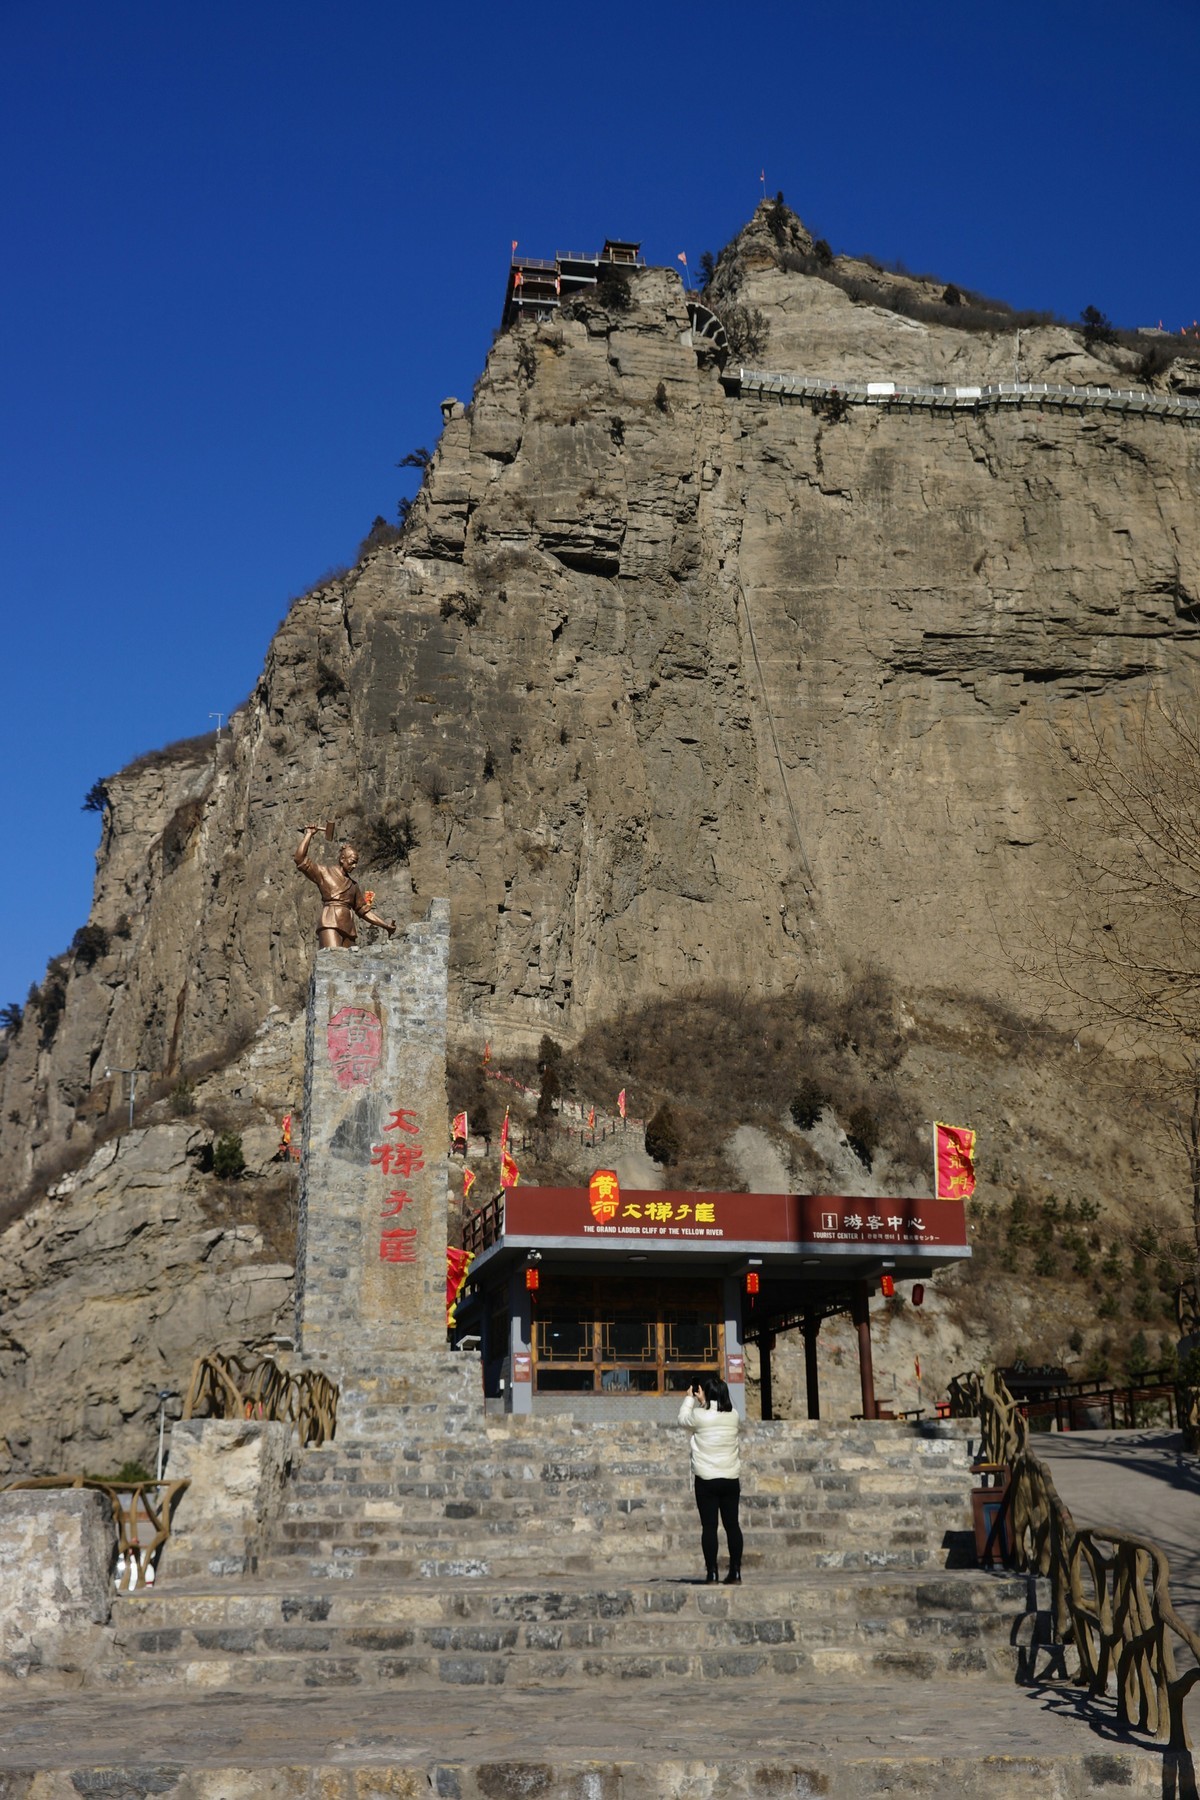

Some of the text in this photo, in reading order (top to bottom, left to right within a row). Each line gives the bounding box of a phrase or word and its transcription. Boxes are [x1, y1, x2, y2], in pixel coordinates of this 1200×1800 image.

[370, 1108, 425, 1263] 大梯子崖
[590, 1175, 619, 1217] 黄河
[622, 1202, 716, 1223] 大梯子崖
[843, 1213, 926, 1232] 游客中心
[583, 1225, 724, 1236] THE GRAND LADDER CLIFF OF THE YELLOW RIVER
[812, 1231, 859, 1240] TOURIST CENTER
